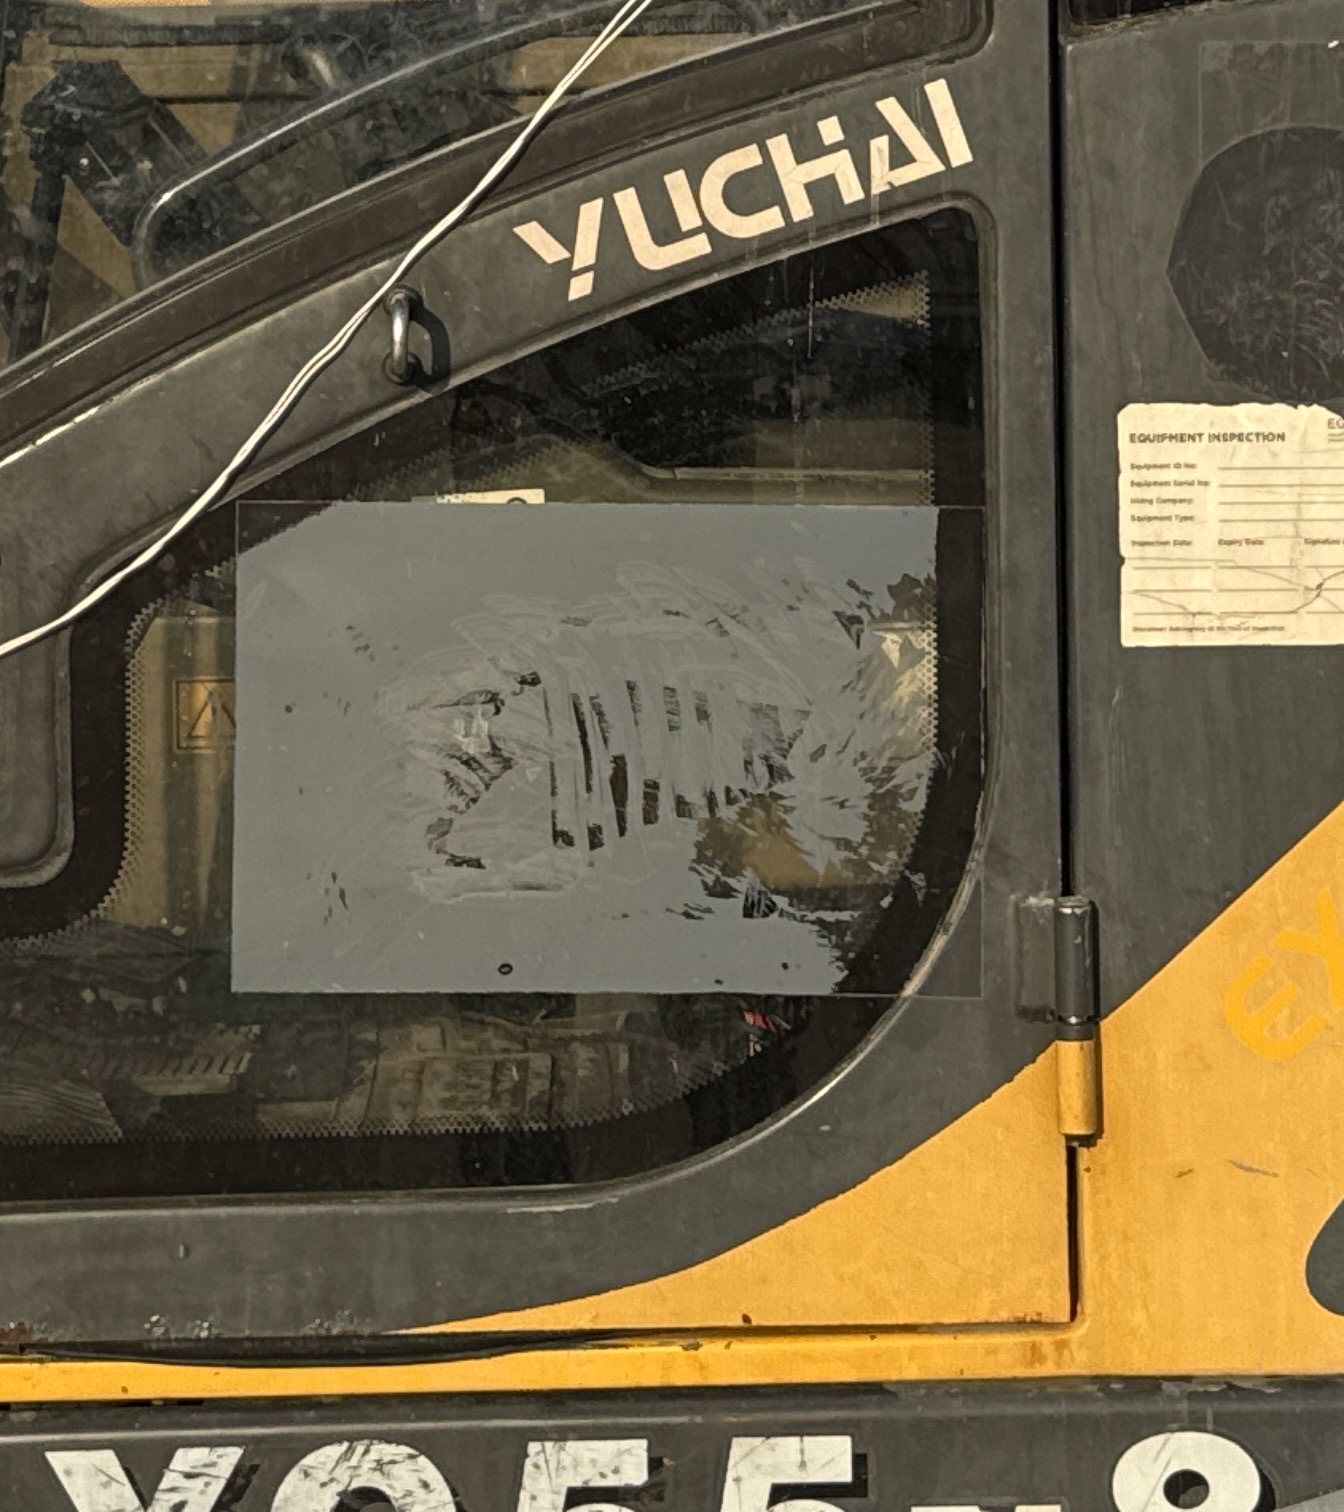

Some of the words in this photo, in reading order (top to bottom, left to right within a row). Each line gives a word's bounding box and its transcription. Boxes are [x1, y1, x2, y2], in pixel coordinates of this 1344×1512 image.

[513, 78, 973, 301] YUCHAI
[1129, 432, 1204, 444] EQUIPMENT
[1208, 431, 1286, 443] INSPECTION
